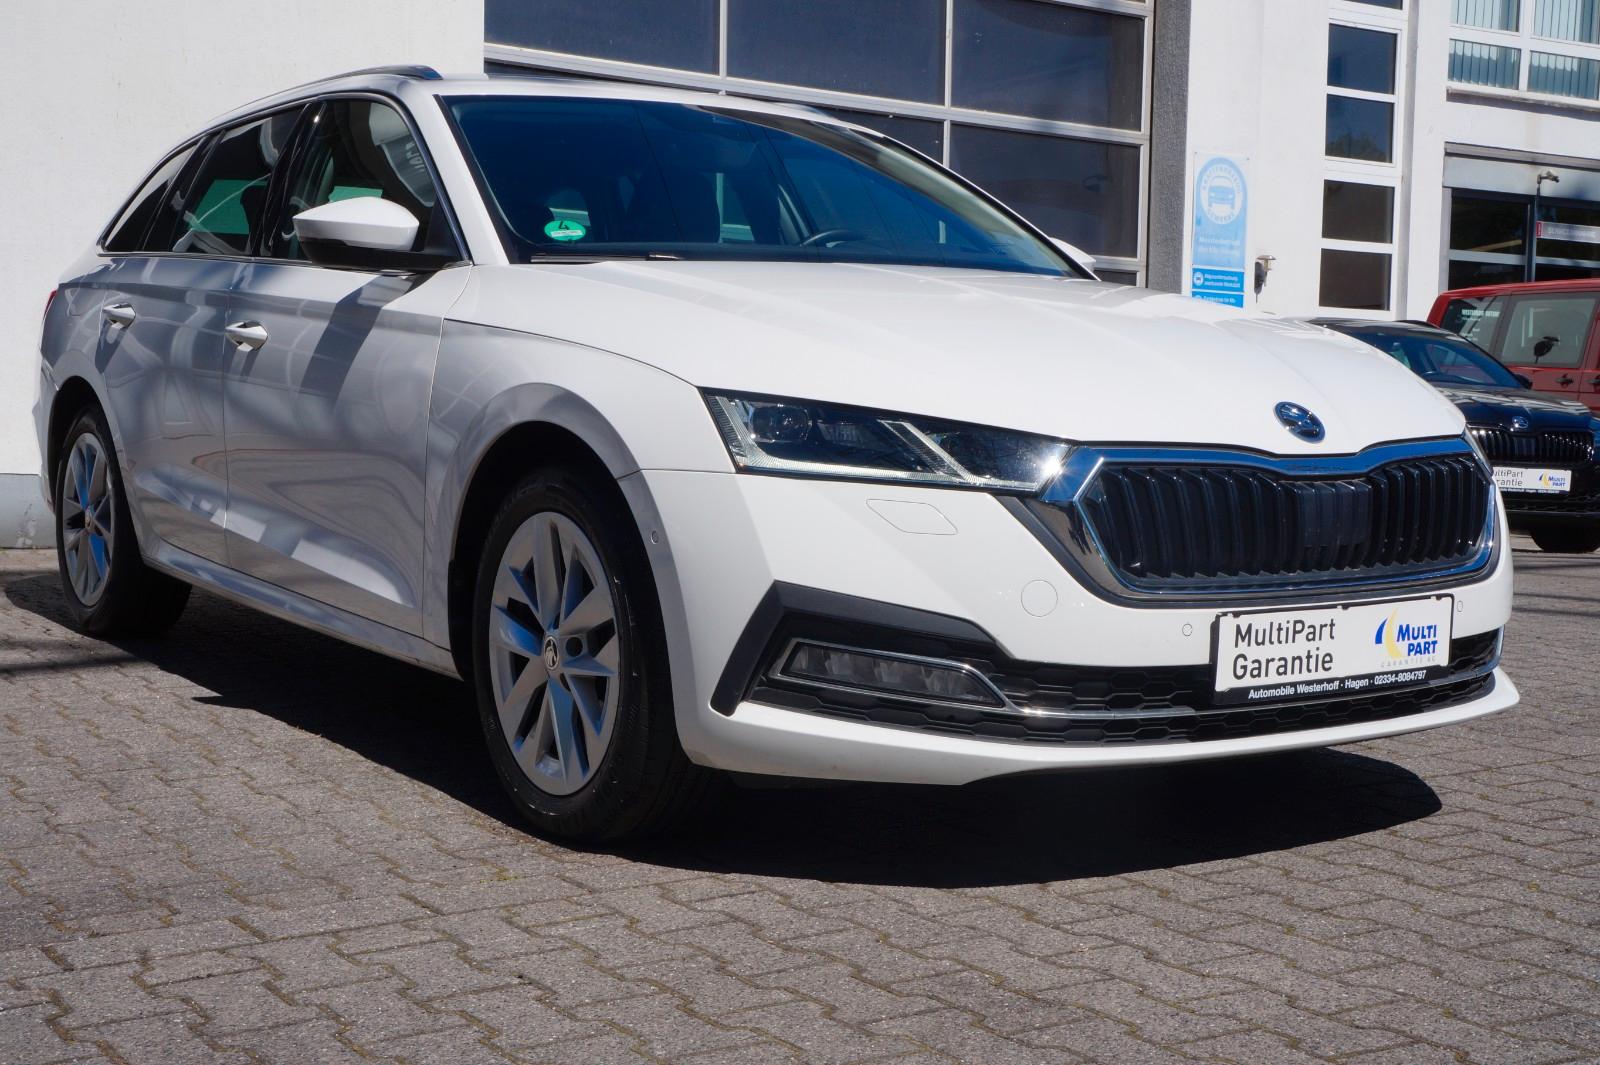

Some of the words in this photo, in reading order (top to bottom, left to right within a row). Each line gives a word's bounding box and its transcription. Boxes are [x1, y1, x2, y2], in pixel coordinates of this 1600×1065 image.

[1494, 469, 1523, 478] ultiPart
[1496, 478, 1523, 487] rantie
[1234, 618, 1336, 648] MultiPart
[1396, 623, 1437, 643] MULTI
[1407, 640, 1438, 657] PART
[1232, 647, 1333, 681] Garantie
[1248, 684, 1295, 700] Automobile
[1296, 680, 1339, 694] Westerhoff
[1345, 678, 1369, 690] Hagen
[1374, 670, 1427, 686] 02334-8084797
